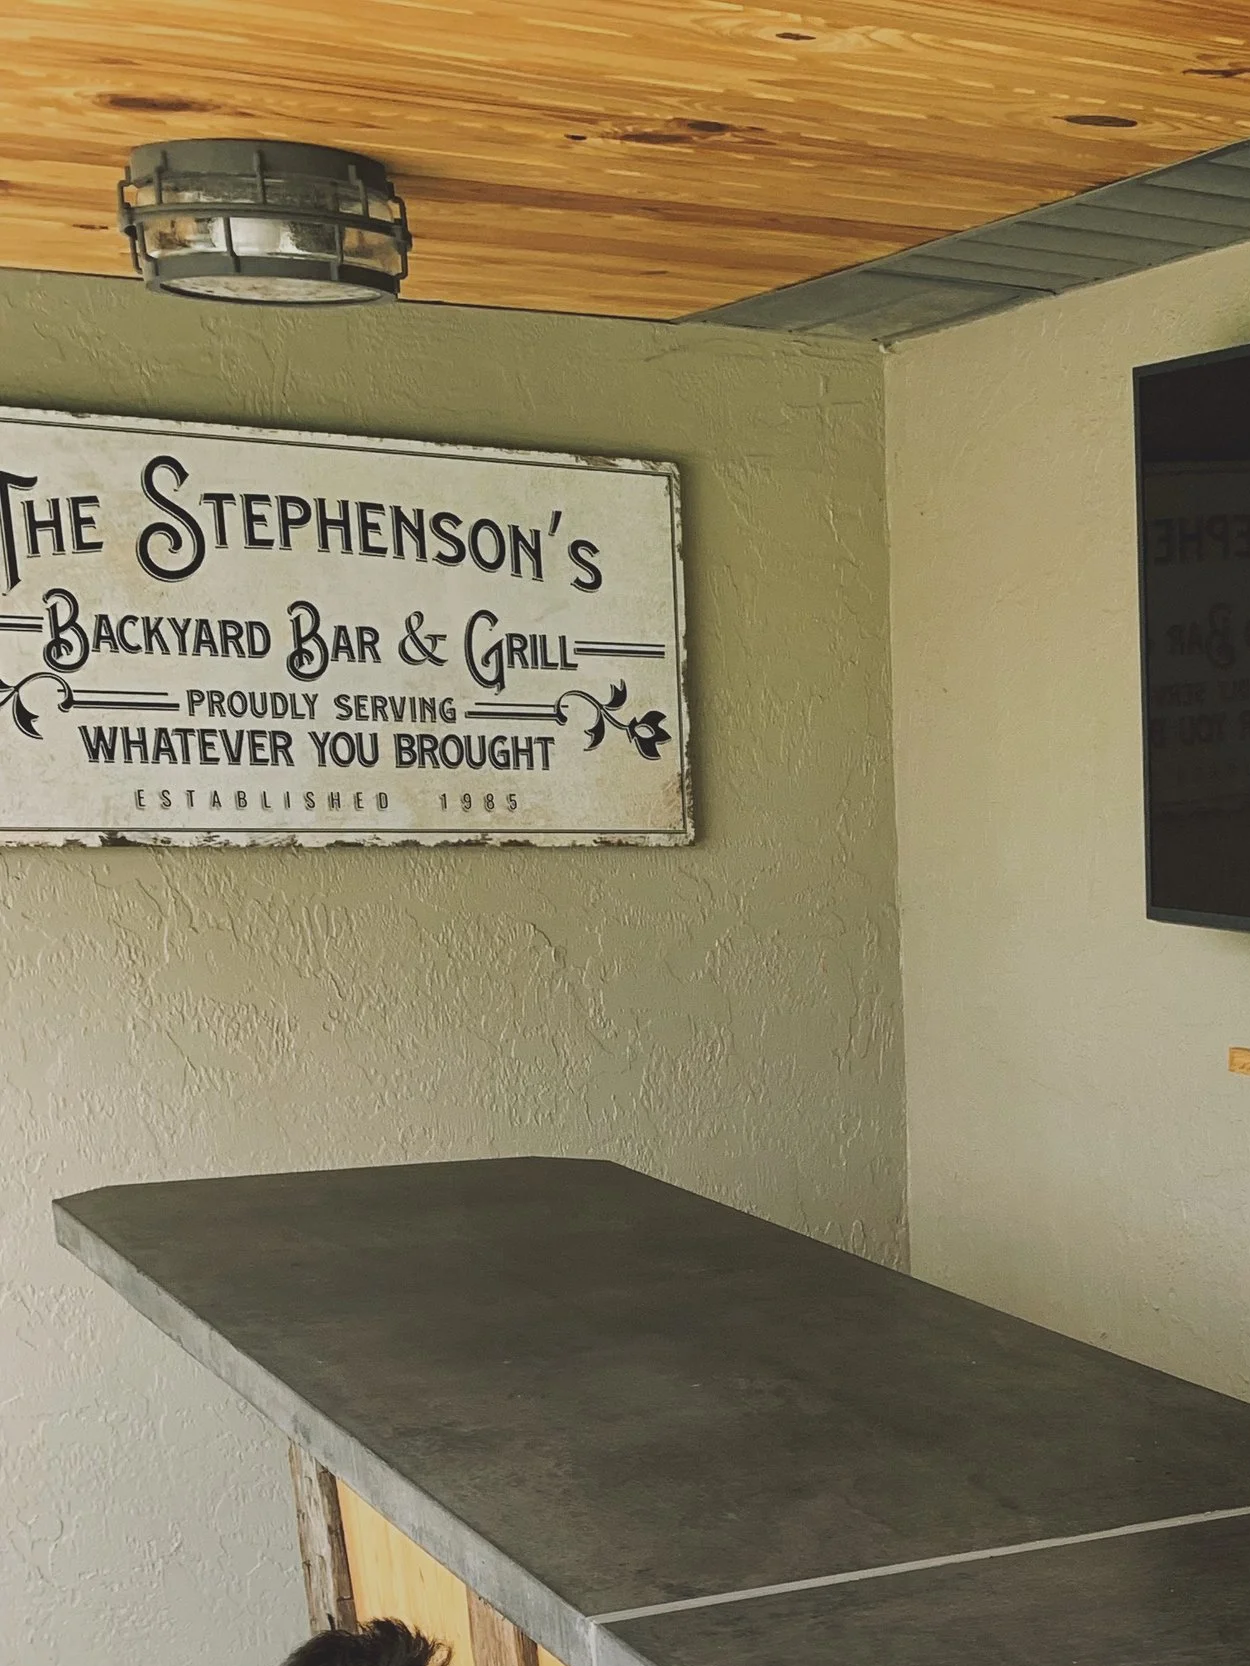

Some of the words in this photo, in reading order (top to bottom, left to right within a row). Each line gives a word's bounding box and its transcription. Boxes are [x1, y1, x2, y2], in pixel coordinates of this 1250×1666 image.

[136, 455, 602, 593] STEPHENSON'S
[42, 588, 271, 673] BACKYARD
[286, 600, 381, 682] BAR
[398, 610, 449, 667] &
[464, 609, 578, 692] GRILL
[186, 689, 319, 721] PROUDLY
[333, 693, 457, 725] SERVING
[78, 725, 295, 767] WHATEVER
[308, 730, 380, 768] YOU
[393, 733, 556, 771] BROUGHT
[136, 788, 390, 811] ESTABLISHED
[439, 792, 519, 813] 1985
